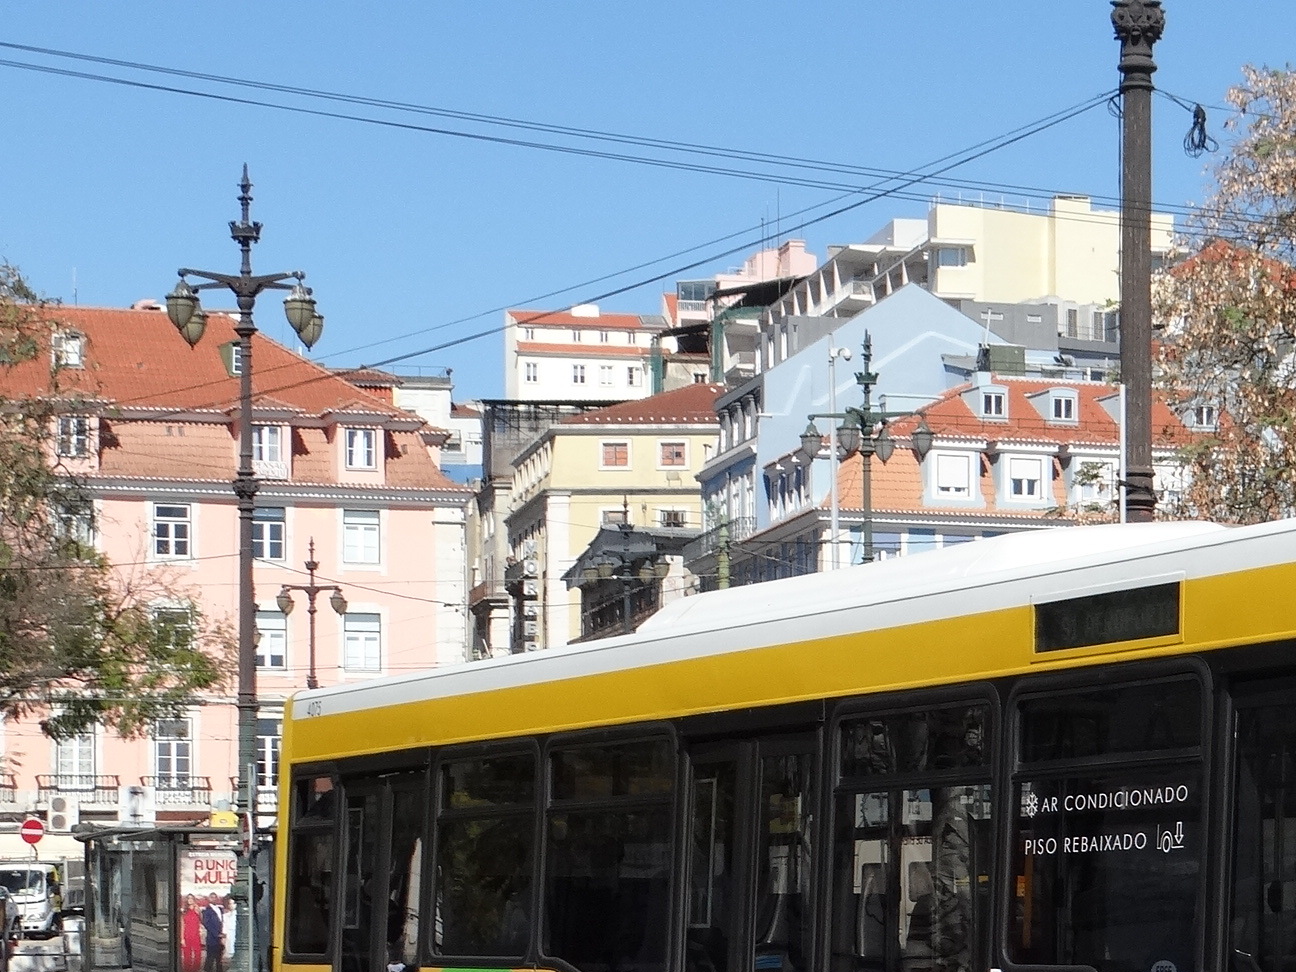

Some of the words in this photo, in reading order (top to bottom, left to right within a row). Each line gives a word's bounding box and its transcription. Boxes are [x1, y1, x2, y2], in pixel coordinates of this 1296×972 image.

[1041, 797, 1058, 813] AR
[1064, 785, 1188, 811] CONDICIONADO
[1025, 838, 1057, 855] PISO
[1063, 832, 1147, 853] REBAIXADO
